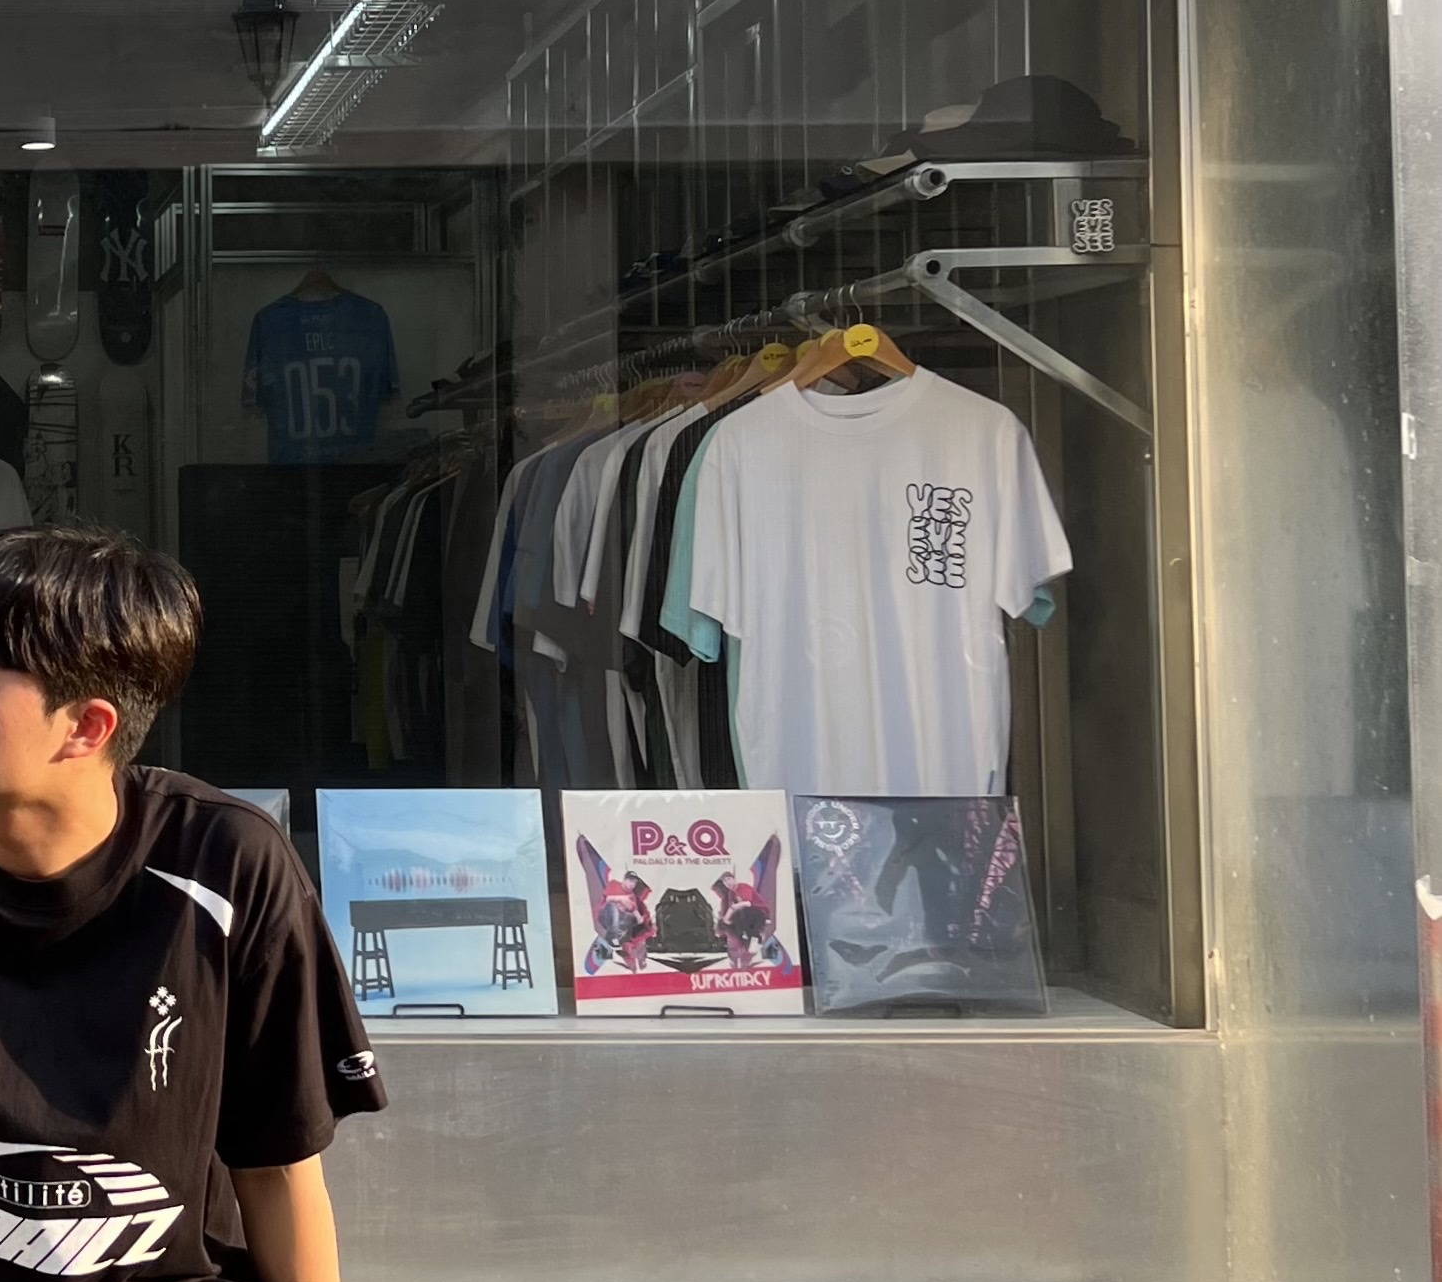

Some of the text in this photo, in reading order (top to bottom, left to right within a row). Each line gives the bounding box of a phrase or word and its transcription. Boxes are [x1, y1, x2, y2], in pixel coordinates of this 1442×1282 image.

[1072, 198, 1114, 218] YES
[1072, 232, 1115, 253] SEE
[906, 482, 973, 527] YES
[906, 546, 966, 589] SEE
[685, 857, 700, 865] THE
[690, 970, 772, 991] SUPREMACY
